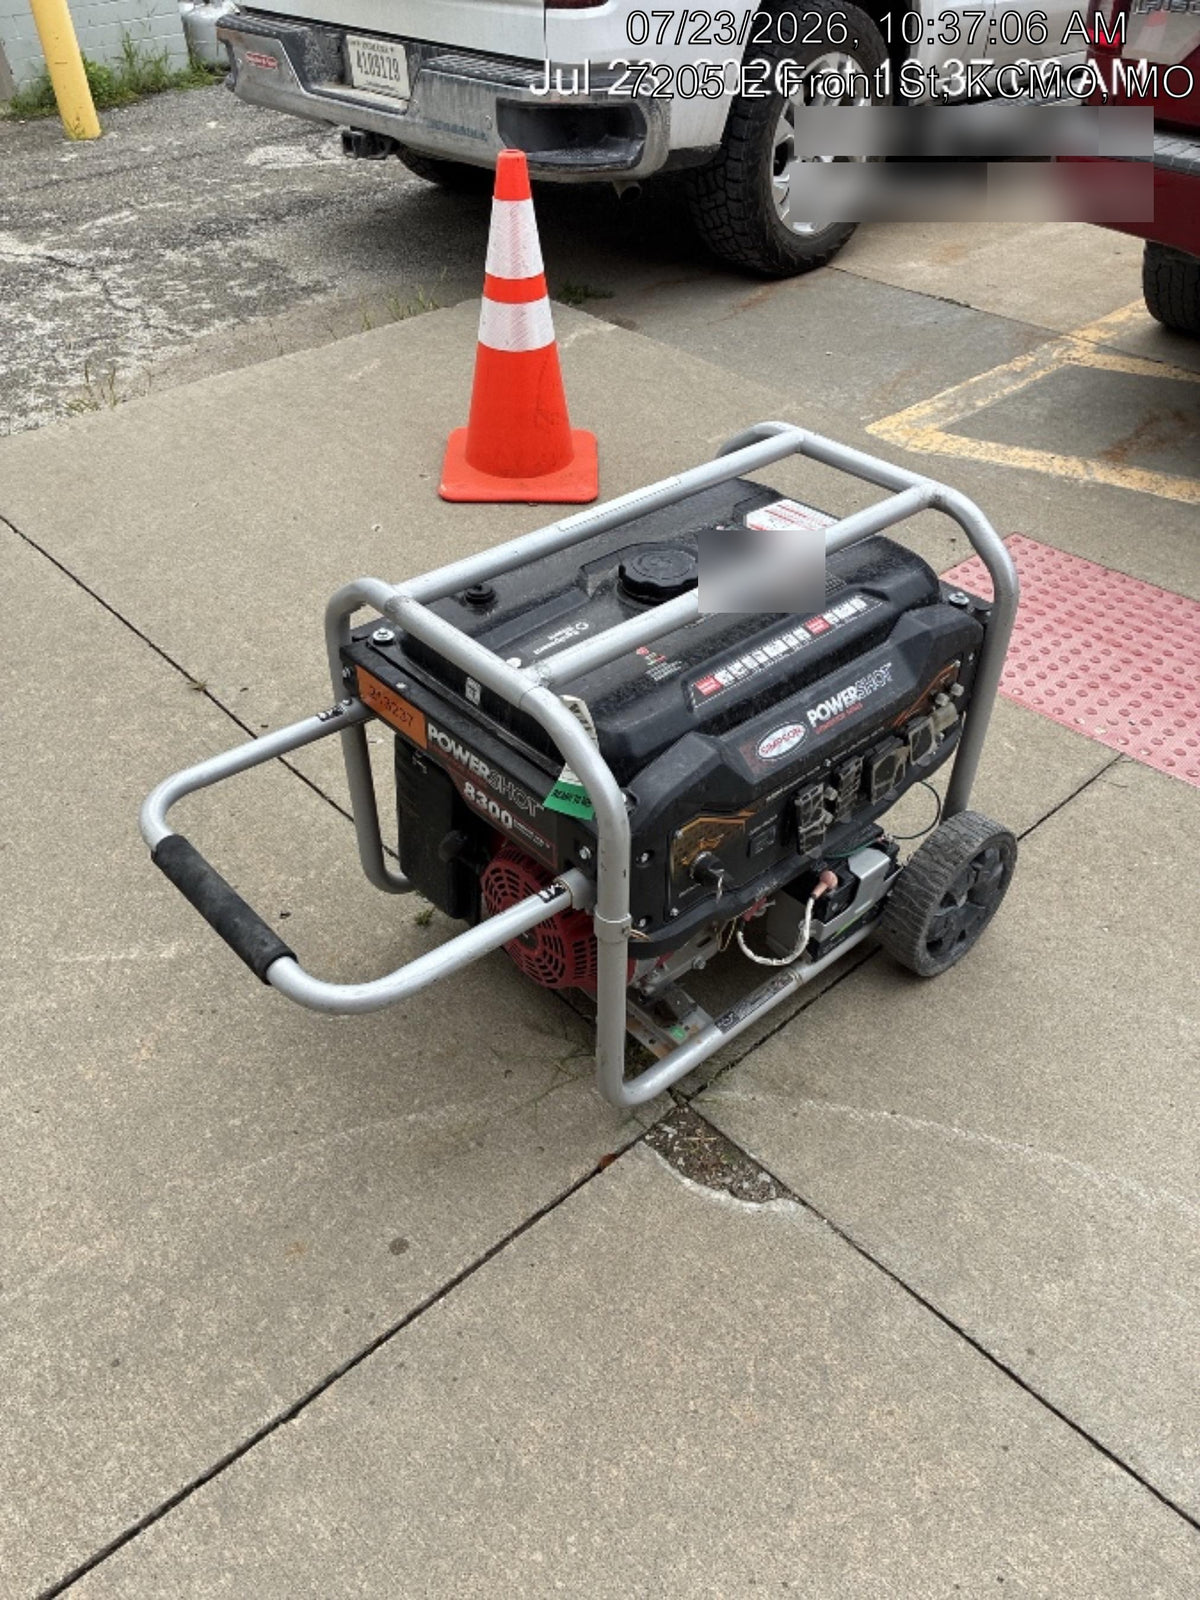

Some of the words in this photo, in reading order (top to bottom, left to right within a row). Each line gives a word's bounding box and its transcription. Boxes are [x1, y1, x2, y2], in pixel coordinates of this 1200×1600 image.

[805, 661, 894, 729] POWERSHOT
[760, 726, 803, 754] SIMPSON
[427, 722, 545, 818] POWERSHOT
[463, 781, 513, 830] 8300
